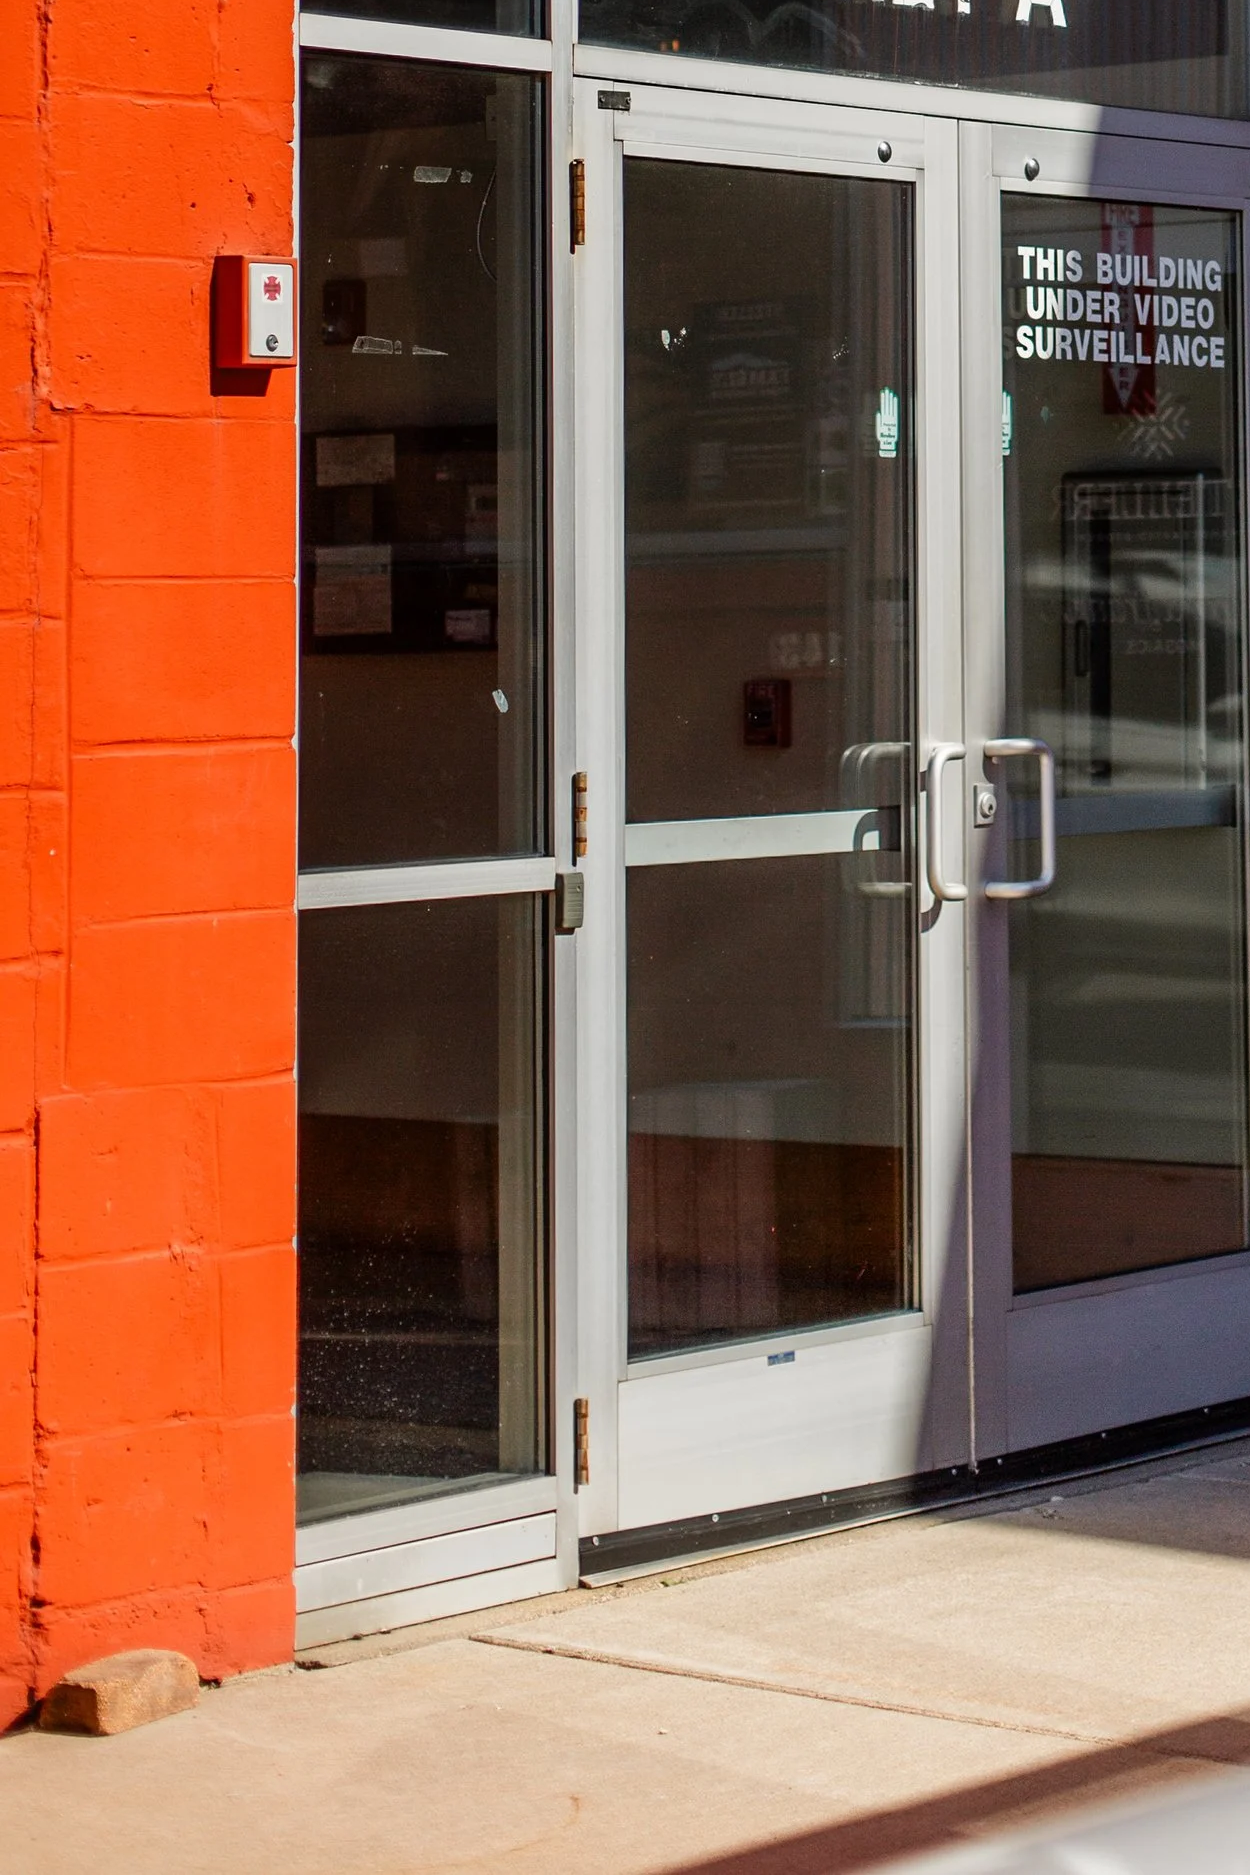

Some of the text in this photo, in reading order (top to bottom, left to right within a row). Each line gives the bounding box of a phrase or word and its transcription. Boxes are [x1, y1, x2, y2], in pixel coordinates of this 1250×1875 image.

[1017, 246, 1222, 292] THIS BUILDING
[1026, 286, 1215, 330] UNDER VIDEO
[1015, 324, 1225, 368] SURVEILLANCE
